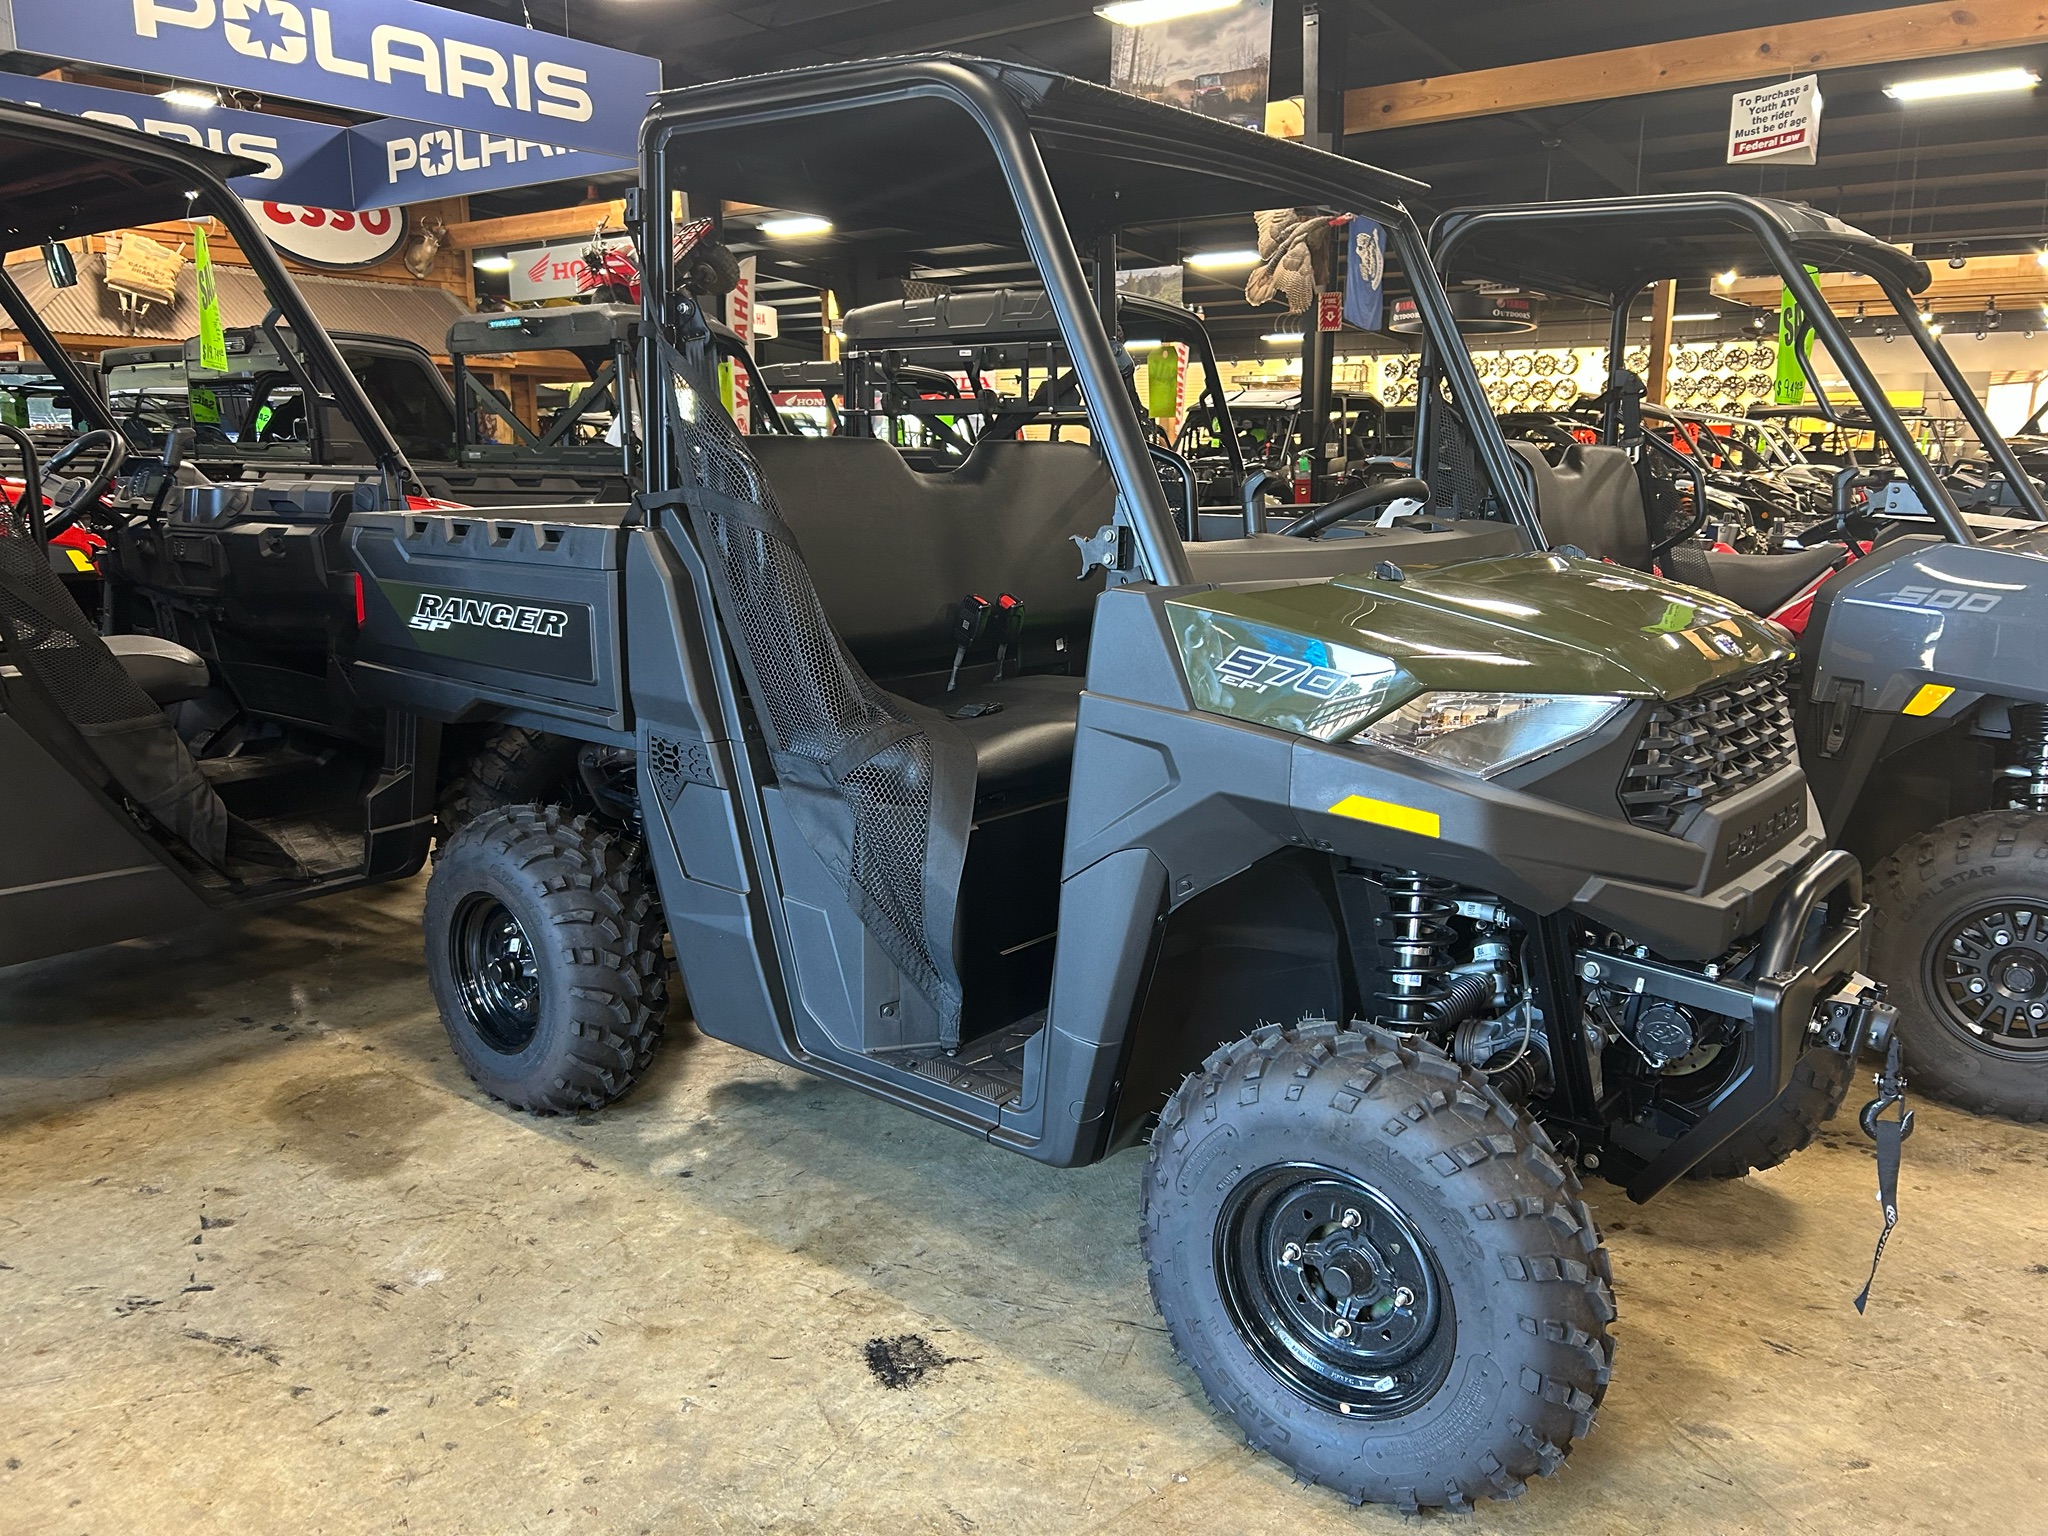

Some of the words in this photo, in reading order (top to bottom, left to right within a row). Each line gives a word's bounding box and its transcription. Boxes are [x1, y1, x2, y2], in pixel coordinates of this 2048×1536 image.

[134, 0, 593, 123] POLARIS
[1739, 98, 1752, 107] To
[1755, 86, 1801, 104] Purchase
[1803, 84, 1809, 92] a
[1748, 104, 1778, 115] Youth
[1780, 96, 1800, 109] ATV
[1735, 127, 1760, 138] Must
[1762, 124, 1775, 133] be
[1777, 120, 1788, 129] of
[1789, 116, 1807, 128] age
[1752, 115, 1769, 125] the
[1771, 109, 1794, 121] rider
[1738, 137, 1778, 152] Federal
[1780, 132, 1800, 145] Law
[1889, 585, 2003, 613] 500
[408, 616, 451, 631] SP
[416, 593, 568, 637] RANGER
[1214, 645, 1352, 699] 570
[1218, 675, 1271, 694] EFI
